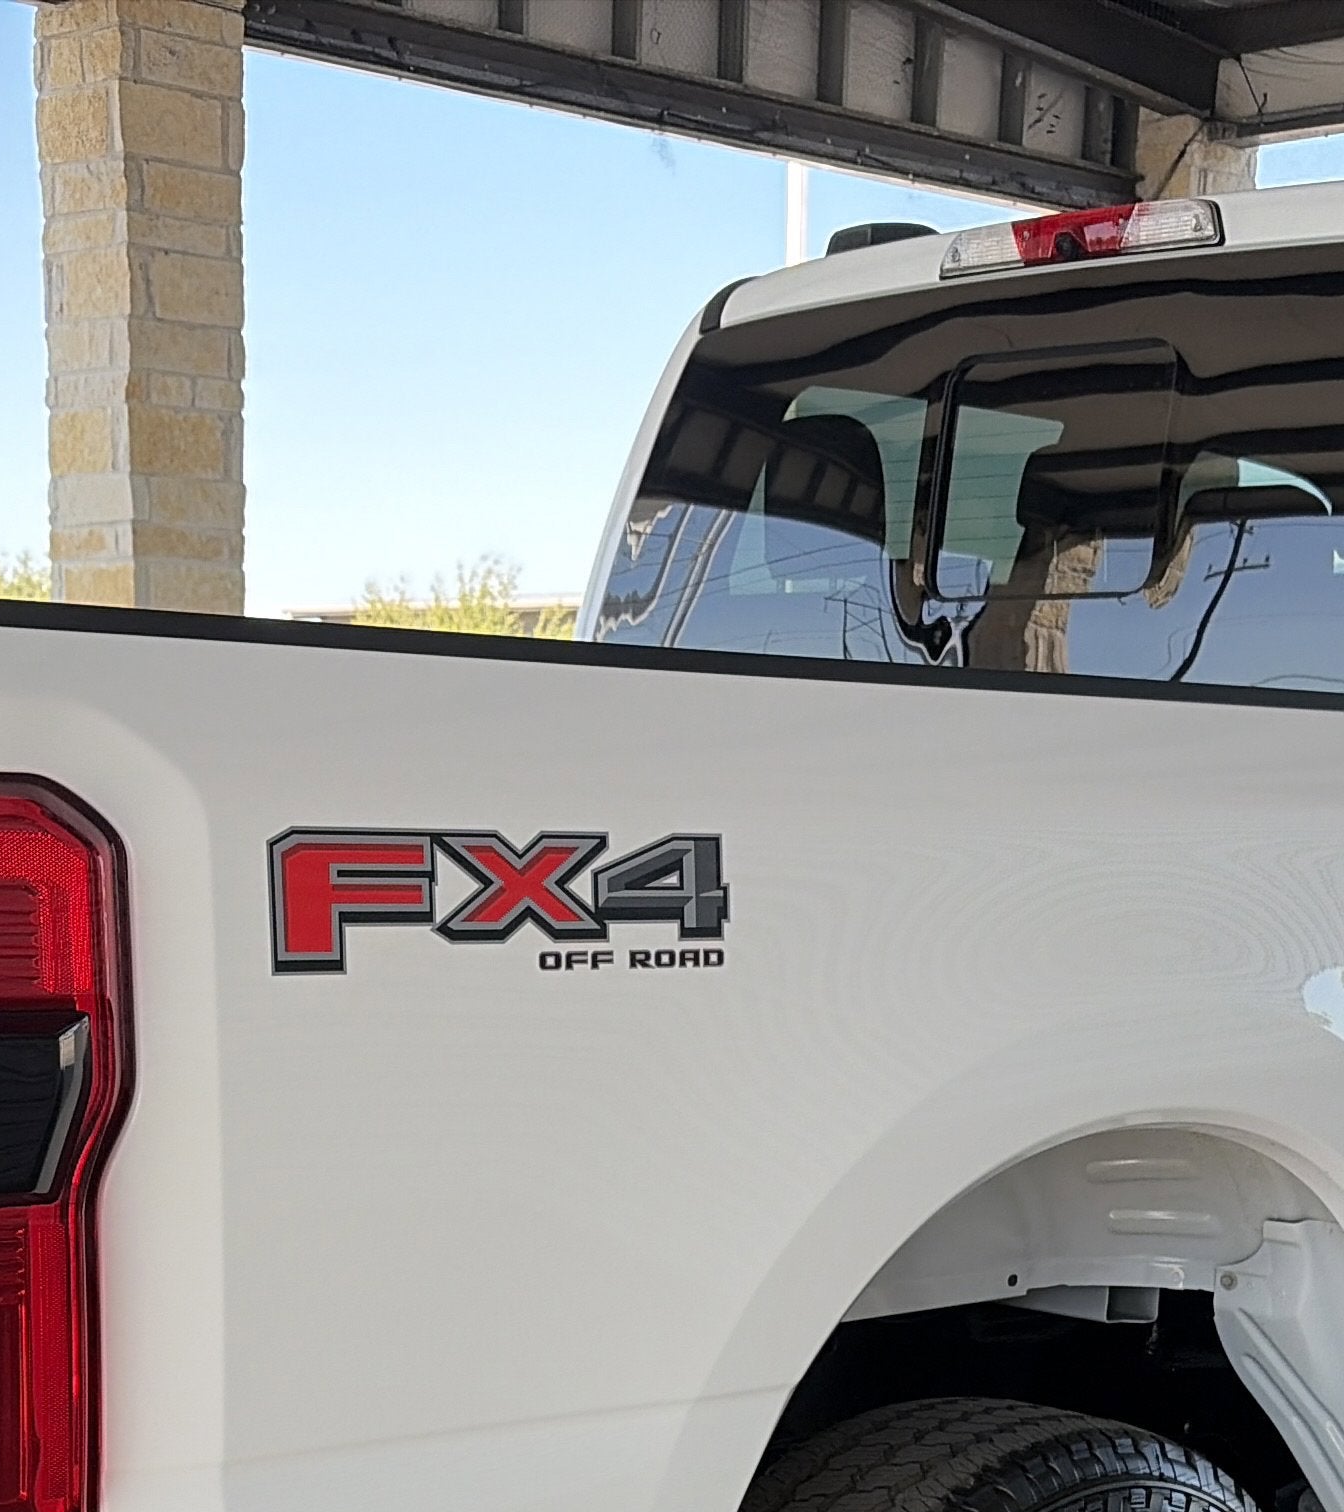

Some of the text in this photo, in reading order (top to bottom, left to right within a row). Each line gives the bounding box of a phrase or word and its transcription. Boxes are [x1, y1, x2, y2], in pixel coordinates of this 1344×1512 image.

[267, 826, 730, 975] FX4
[539, 948, 724, 971] OFF ROAD
